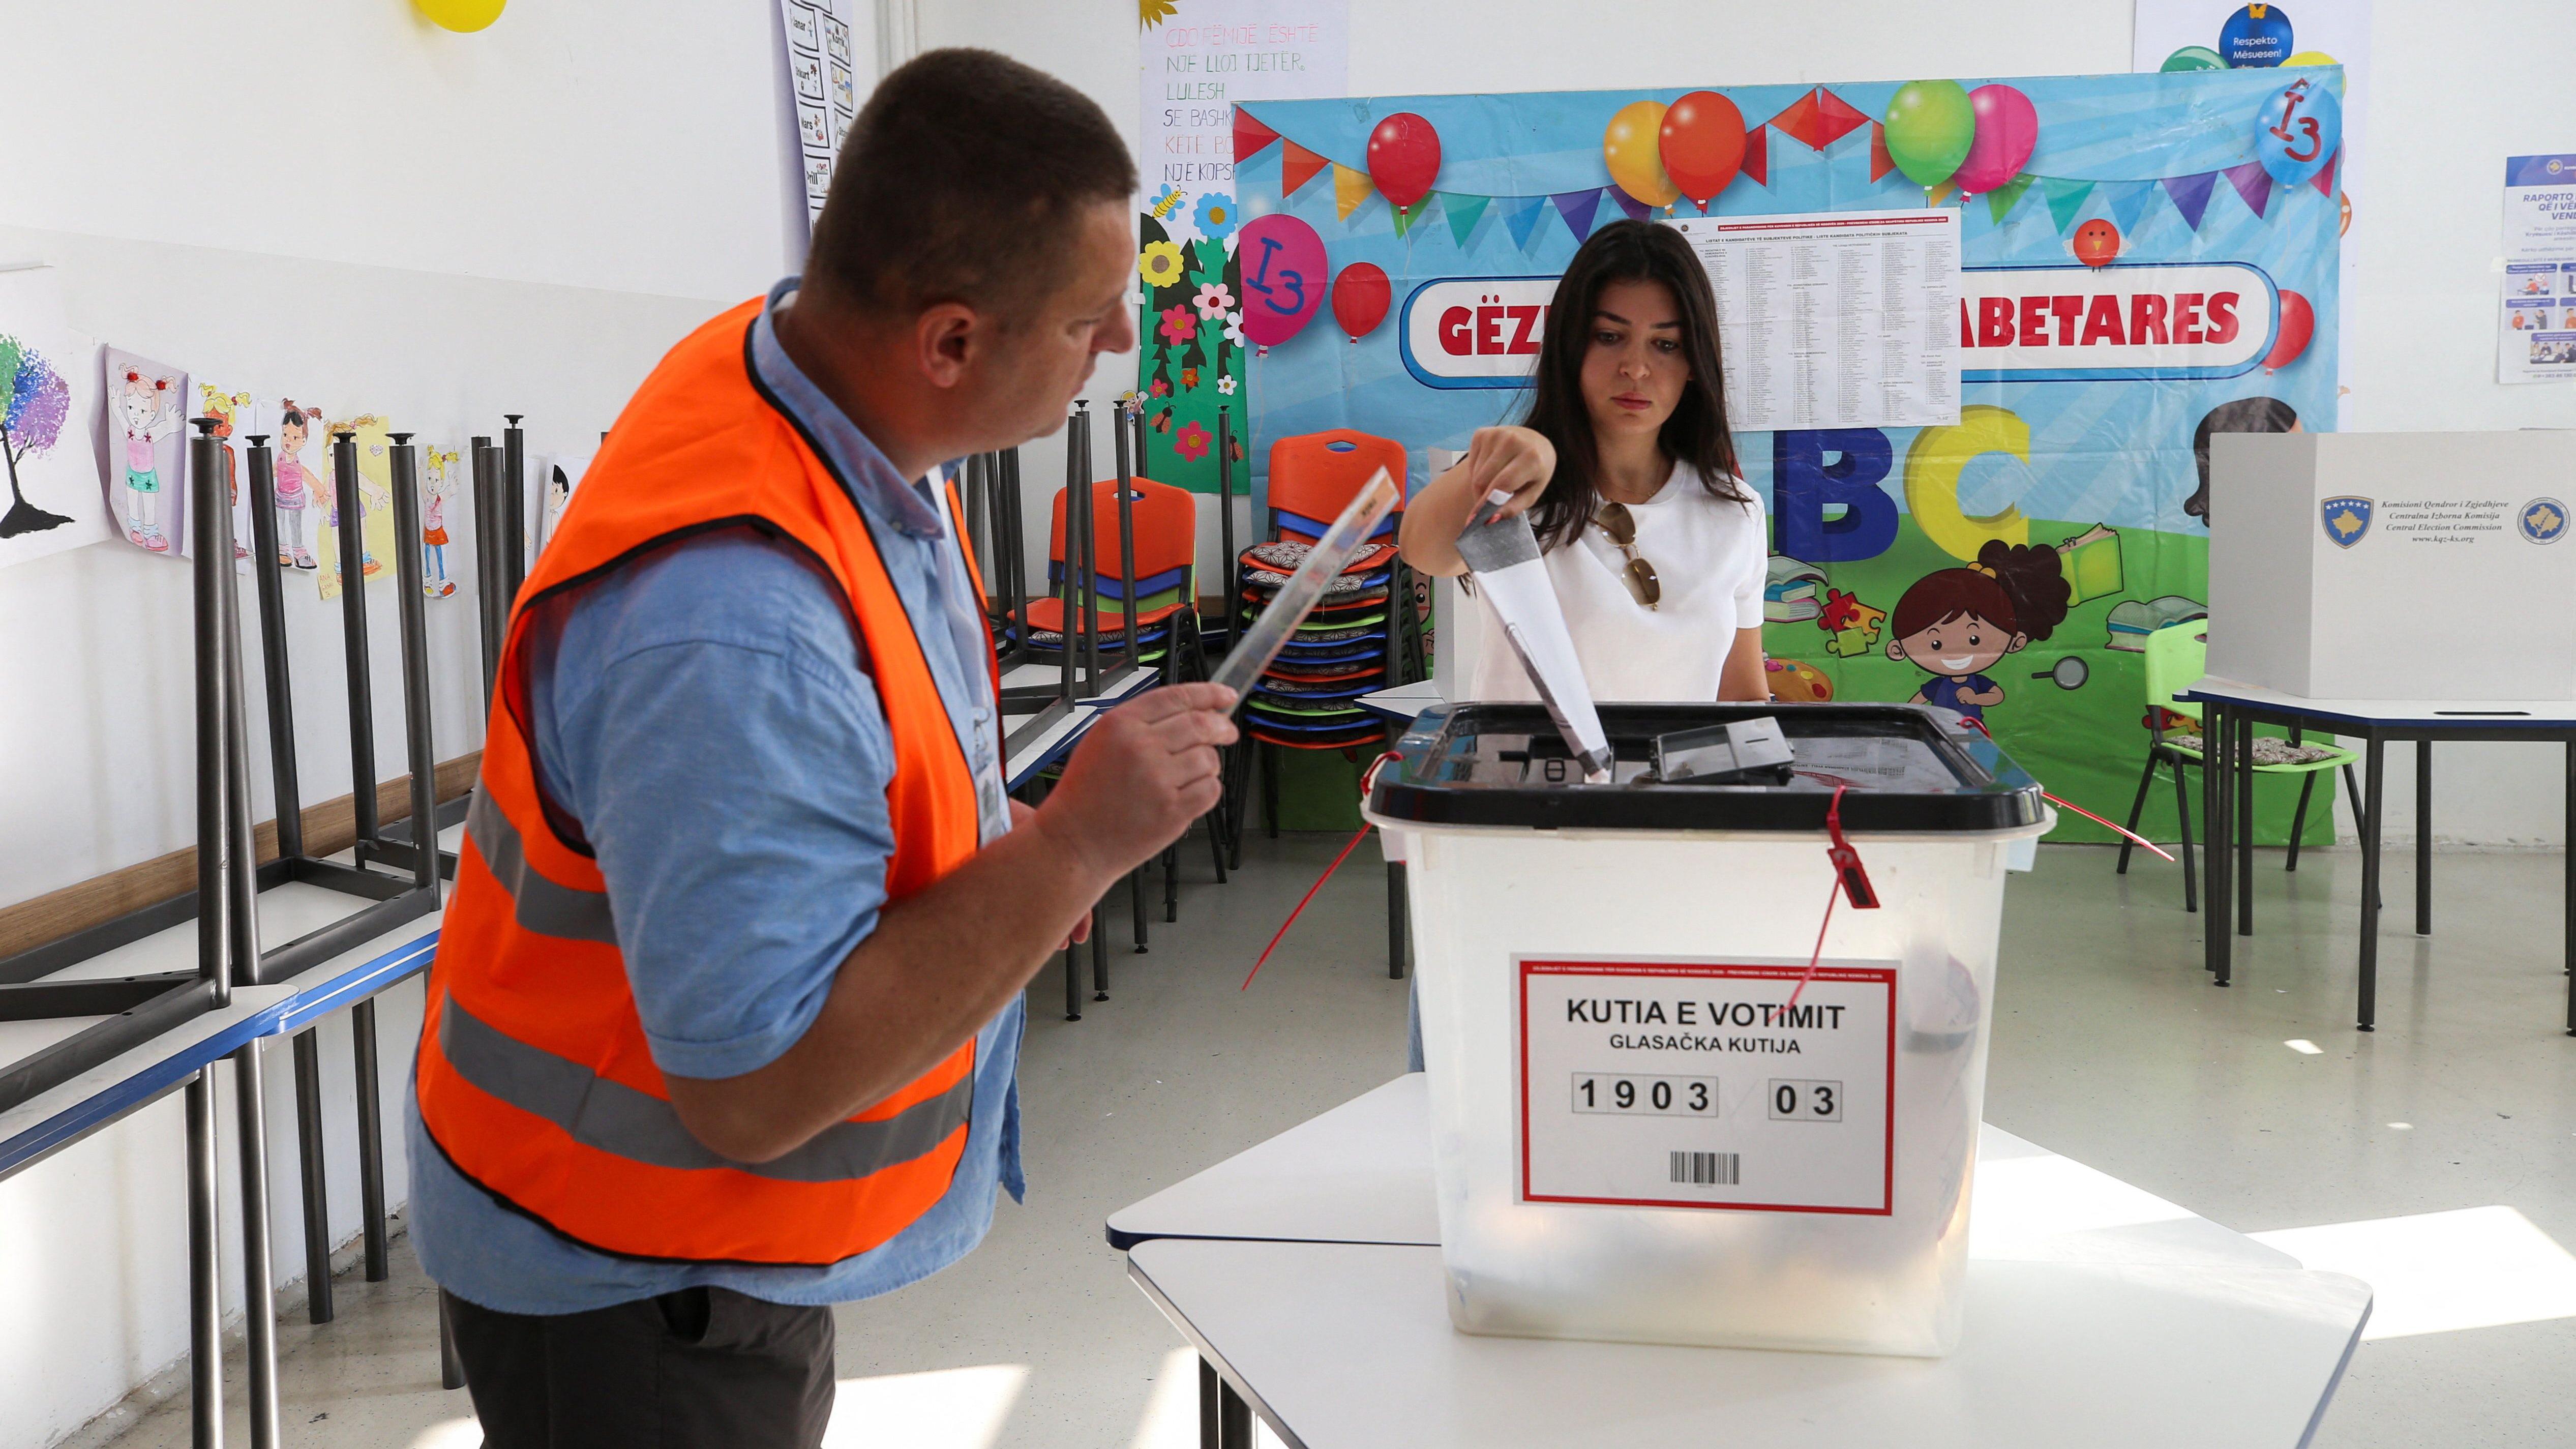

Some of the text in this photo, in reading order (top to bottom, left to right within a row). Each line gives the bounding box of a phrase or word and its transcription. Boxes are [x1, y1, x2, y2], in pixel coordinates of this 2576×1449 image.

[1269, 23, 1319, 43] ËSHTË
[2233, 37, 2278, 47] Respekto
[1206, 54, 1237, 72] LLOJ
[2233, 49, 2282, 60] Mësuesen!
[1166, 82, 1224, 100] LULESH
[1163, 109, 1183, 127] SE
[1165, 134, 1206, 154] KËTË
[1164, 161, 1194, 181] NJË
[2523, 193, 2573, 202] RAPORTO
[1439, 294, 1551, 356] GËZ
[2424, 500, 2458, 509] Qendror
[2465, 500, 2509, 510] Zgjedhjeve
[2431, 512, 2463, 520] Izborna
[2464, 512, 2500, 521] Komisija
[2412, 535, 2475, 544] www.kqz-ks.org
[1568, 999, 1845, 1029] KUTIA E VOTIMIT
[1610, 1032, 1801, 1054] GLASAČKA KUTIJA
[1580, 1079, 1834, 1115] 1903 03
